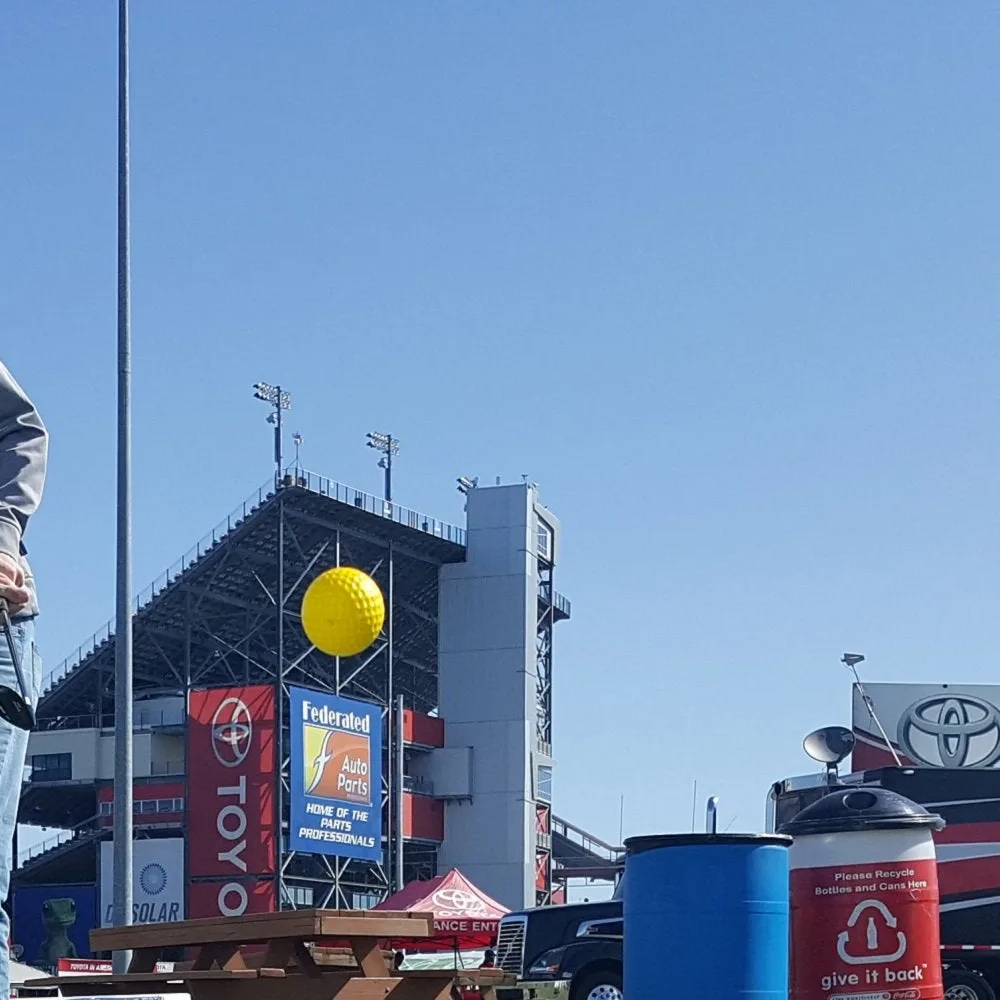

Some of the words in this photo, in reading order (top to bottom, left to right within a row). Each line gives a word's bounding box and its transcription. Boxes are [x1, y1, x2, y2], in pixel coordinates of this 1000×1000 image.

[302, 700, 370, 734] Federated
[342, 755, 368, 775] Auto
[337, 774, 368, 796] Parts
[306, 802, 335, 817] HOME
[336, 807, 349, 818] OF
[352, 810, 369, 822] THE
[320, 818, 352, 832] PARTS
[298, 828, 375, 848] PROFESSIONALS
[834, 871, 872, 881] Please
[875, 868, 914, 880] Recycle
[815, 886, 852, 895] Bottles
[855, 883, 876, 893] and
[879, 882, 906, 891] Cans
[908, 880, 927, 888] Here
[132, 902, 179, 922] SOLAR
[821, 971, 859, 990] give
[865, 969, 879, 983] it
[885, 965, 923, 982] back
